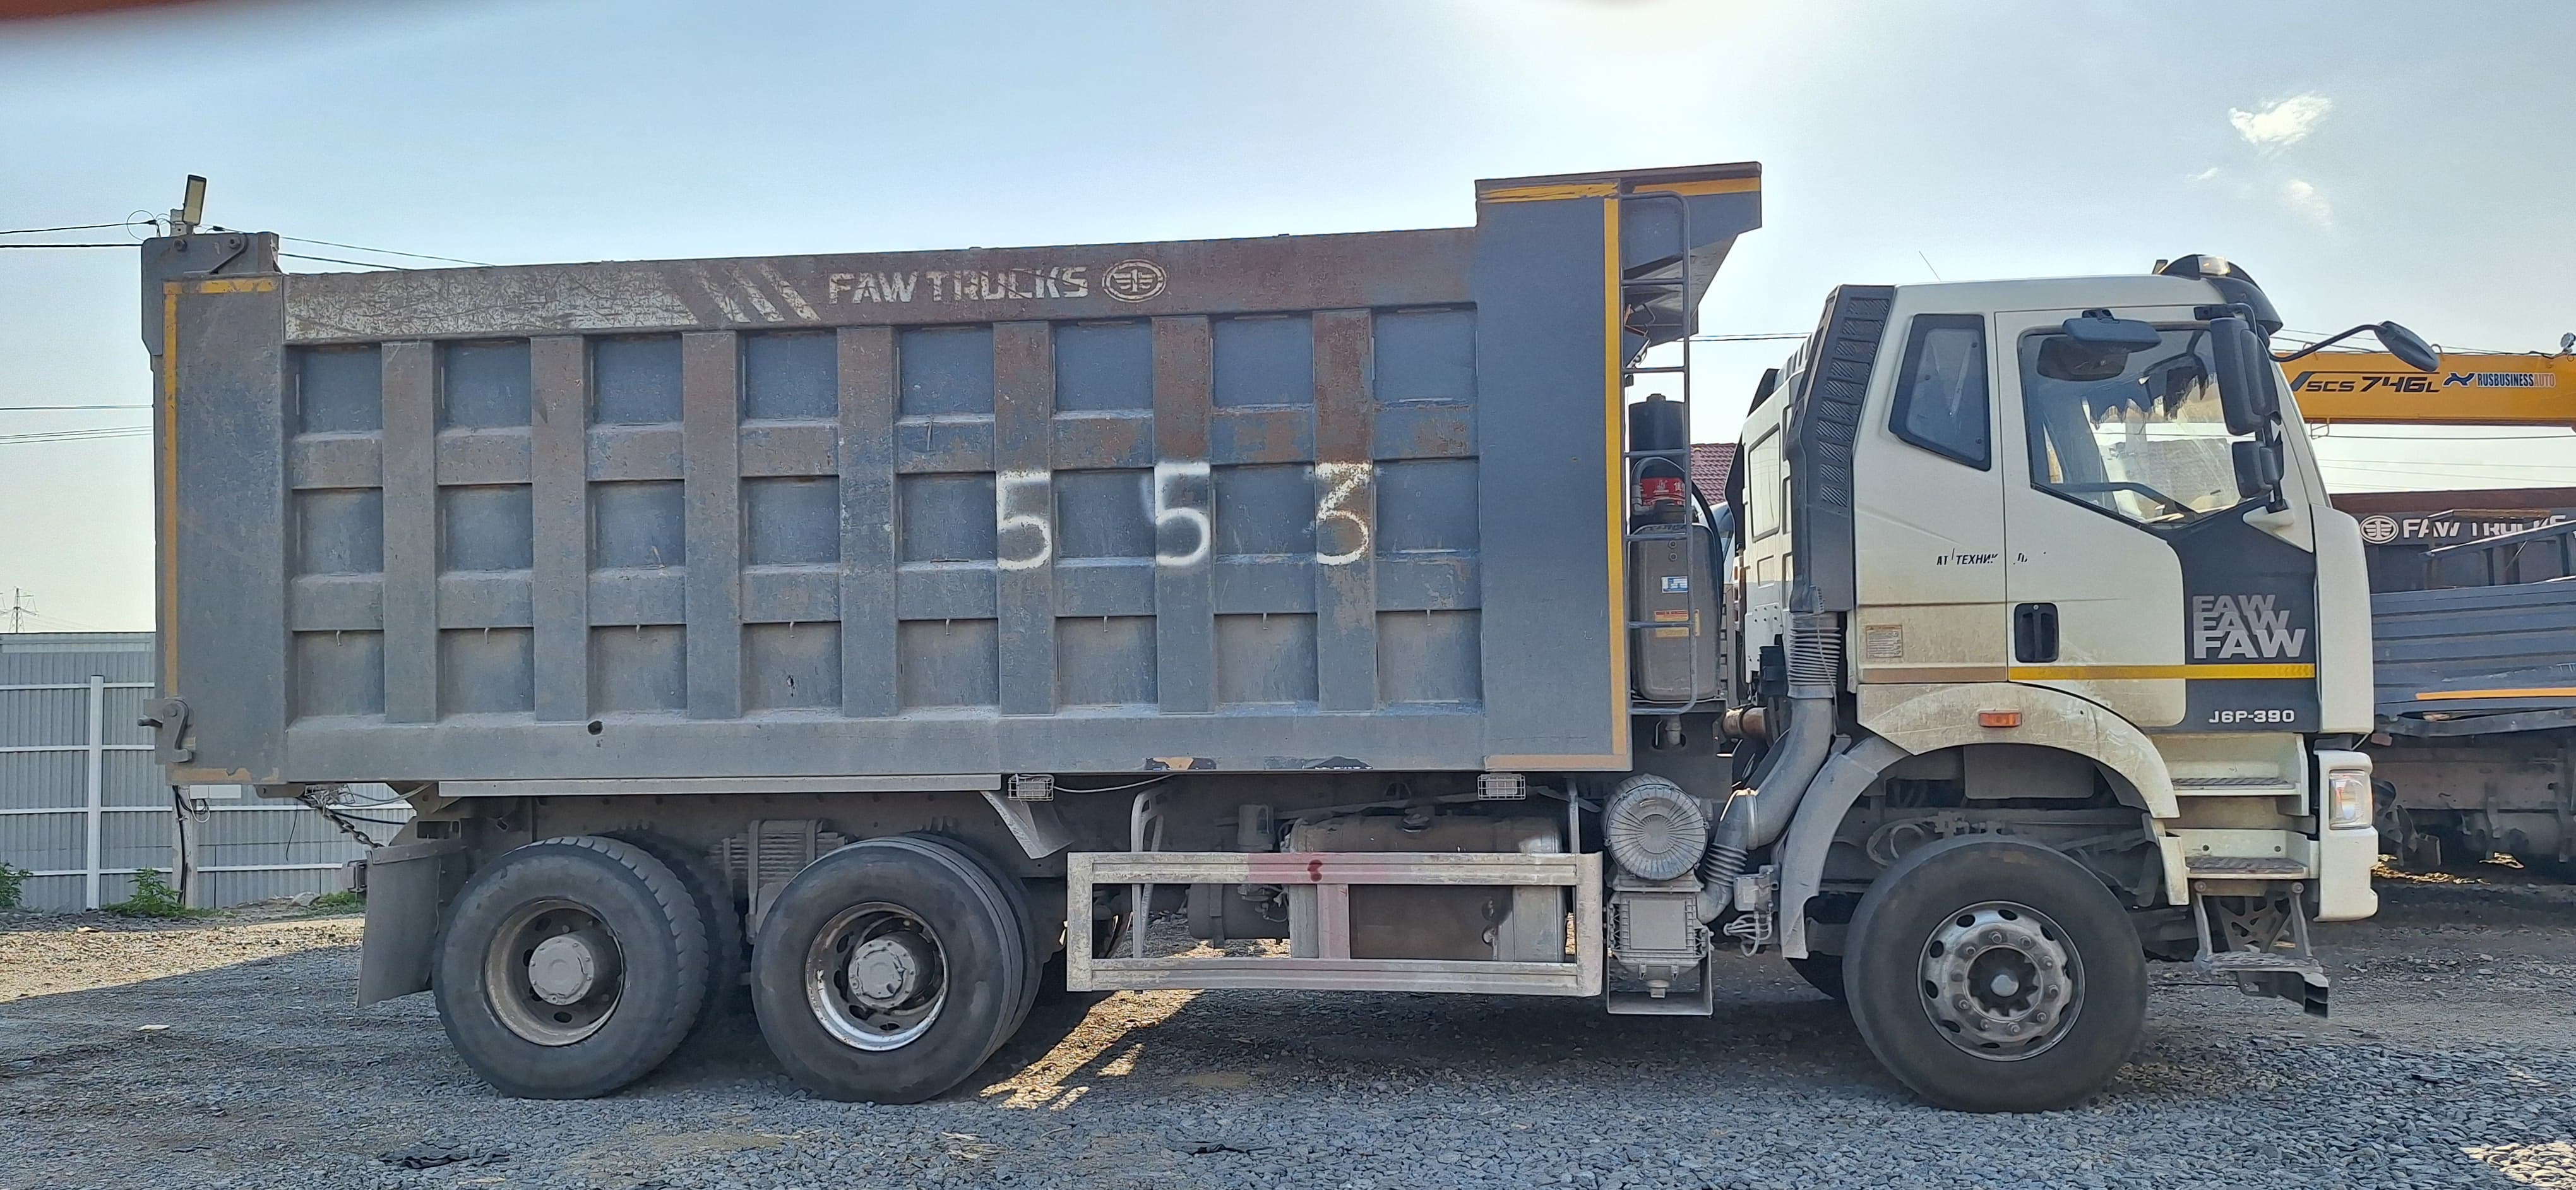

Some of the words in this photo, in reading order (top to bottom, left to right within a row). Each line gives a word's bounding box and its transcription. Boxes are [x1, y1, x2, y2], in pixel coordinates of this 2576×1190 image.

[829, 271, 919, 304] FAW
[926, 267, 1088, 302] TRUCKS
[2305, 381, 2356, 392] SCS
[2359, 376, 2440, 392] 746L
[2192, 594, 2276, 617] FAW
[2193, 610, 2290, 635] FAW
[2193, 628, 2306, 659] FAW
[2209, 710, 2295, 723] J6P-390
